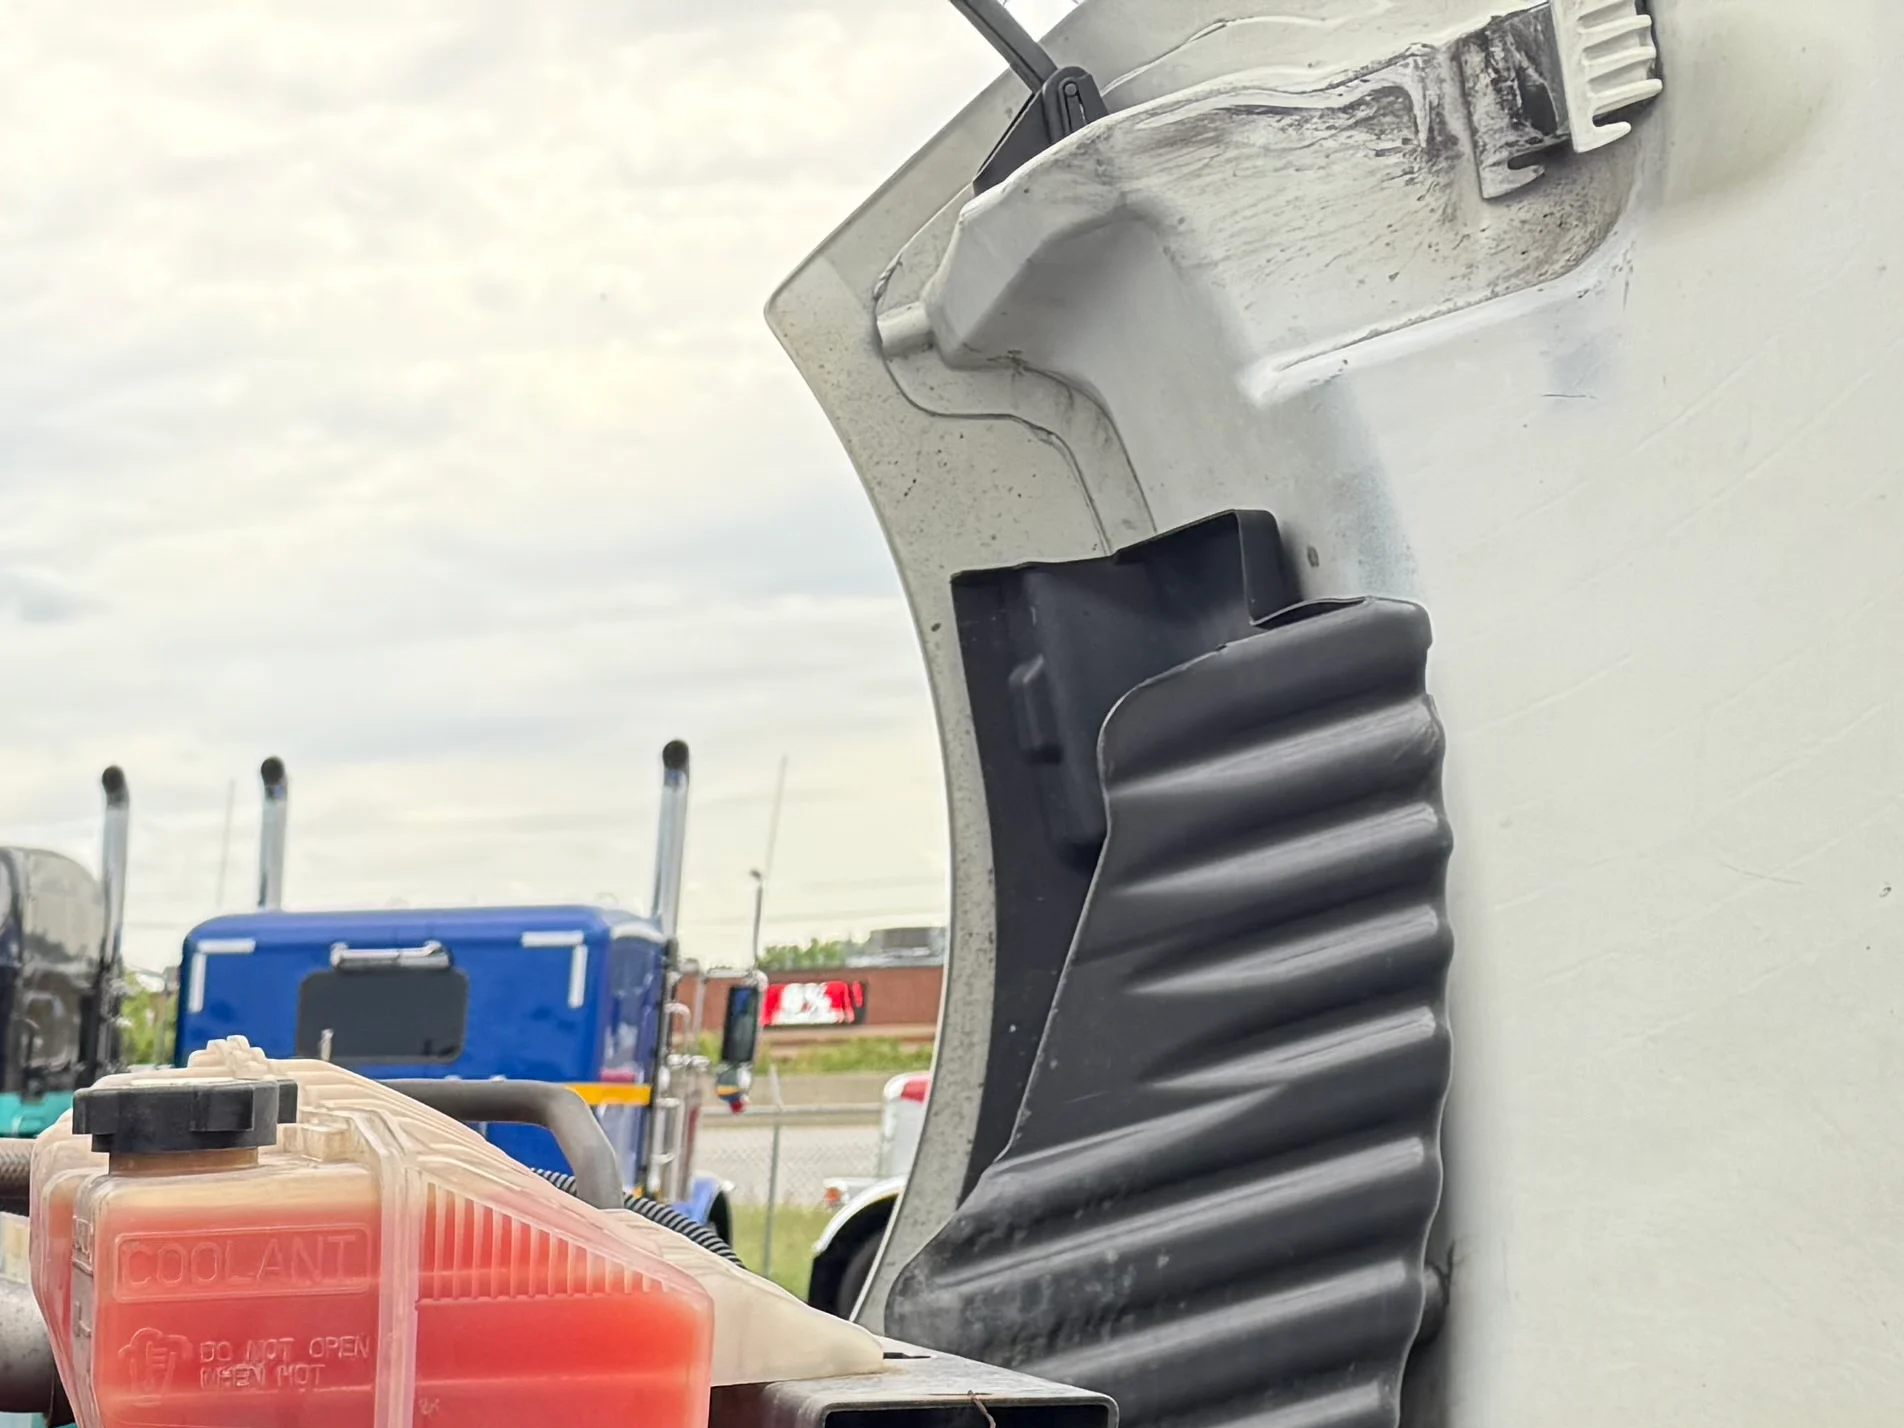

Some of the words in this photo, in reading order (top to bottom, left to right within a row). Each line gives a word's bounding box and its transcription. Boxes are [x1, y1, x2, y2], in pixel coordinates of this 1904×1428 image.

[122, 1234, 356, 1286] COOLANT
[199, 1341, 234, 1363] DO
[246, 1338, 295, 1361] NOT
[308, 1336, 370, 1360] OPEN
